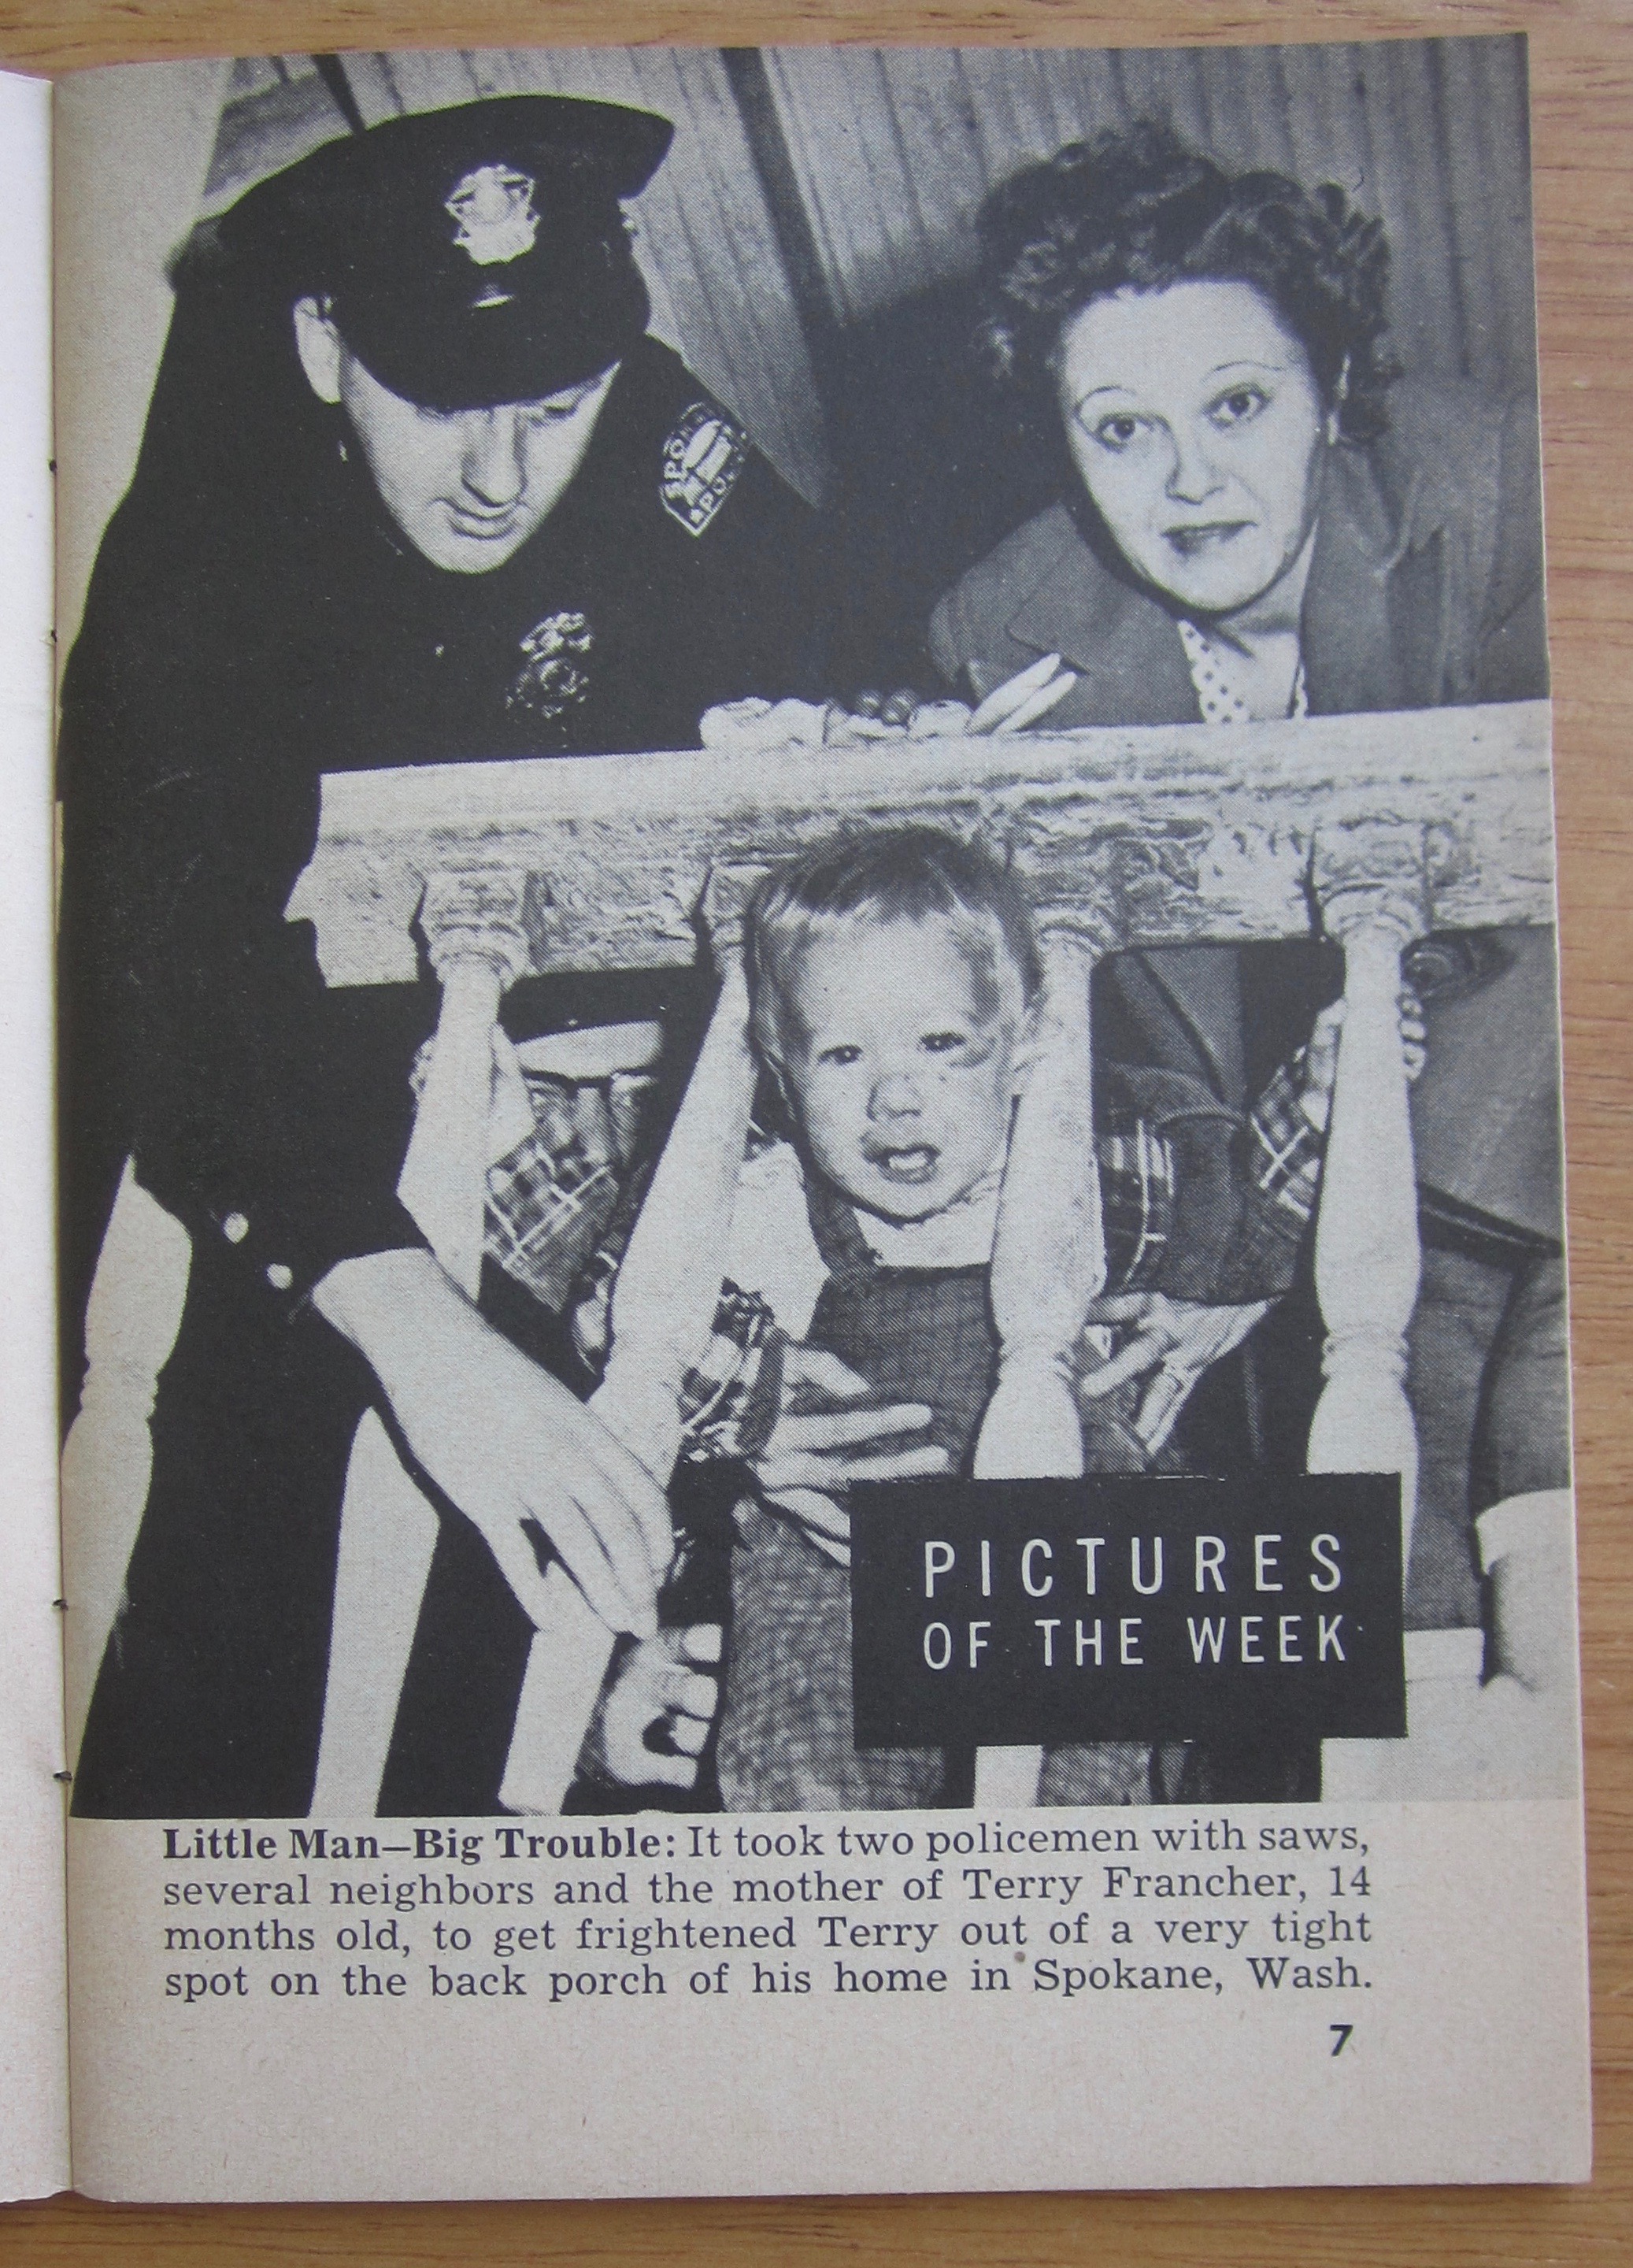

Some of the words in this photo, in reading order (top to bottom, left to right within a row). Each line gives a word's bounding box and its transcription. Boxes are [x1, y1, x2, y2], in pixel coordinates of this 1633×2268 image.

[924, 1533, 1341, 1598] PICTURES
[923, 1621, 991, 1670] OF
[1034, 1618, 1144, 1667] THE
[1187, 1614, 1346, 1664] WEEK
[162, 1828, 276, 1859] Little
[495, 1826, 674, 1858] Trouble:
[687, 1825, 721, 1858] It
[734, 1825, 824, 1857] took
[837, 1825, 913, 1856] two
[926, 1821, 1139, 1862] policemen
[1152, 1818, 1246, 1851] with
[1259, 1827, 1369, 1855] saws,
[164, 1873, 311, 1905] several
[330, 1873, 534, 1913] neighbors
[554, 1872, 629, 1904] and
[648, 1872, 713, 1903] the
[733, 1870, 883, 1903] mother
[903, 1868, 943, 1901] of
[963, 1869, 1083, 1905] Terry
[1103, 1865, 1306, 1901] Francher,
[1330, 1866, 1370, 1896] 14
[164, 1918, 315, 1951] months
[336, 1919, 410, 1958] old,
[433, 1921, 472, 1951] to
[494, 1920, 556, 1957] get
[576, 1916, 796, 1956] frightened
[818, 1916, 939, 1953] Terry
[961, 1915, 1028, 1946] out
[1050, 1912, 1089, 1944] of
[1111, 1922, 1133, 1944] a
[1155, 1920, 1249, 1950] very
[1272, 1910, 1371, 1950] tight
[165, 1966, 249, 2003] spot
[270, 1973, 320, 1996] on
[341, 1964, 407, 1996] the
[428, 1964, 527, 1996] back
[549, 1963, 667, 2003] porch
[690, 1962, 730, 1995] of
[752, 1962, 811, 1994] his
[834, 1961, 947, 1992] home
[971, 1959, 1011, 1991] in
[1034, 1958, 1223, 1997] Spokane,
[1246, 1956, 1371, 1989] Wash.
[1330, 2024, 1353, 2056] 7
